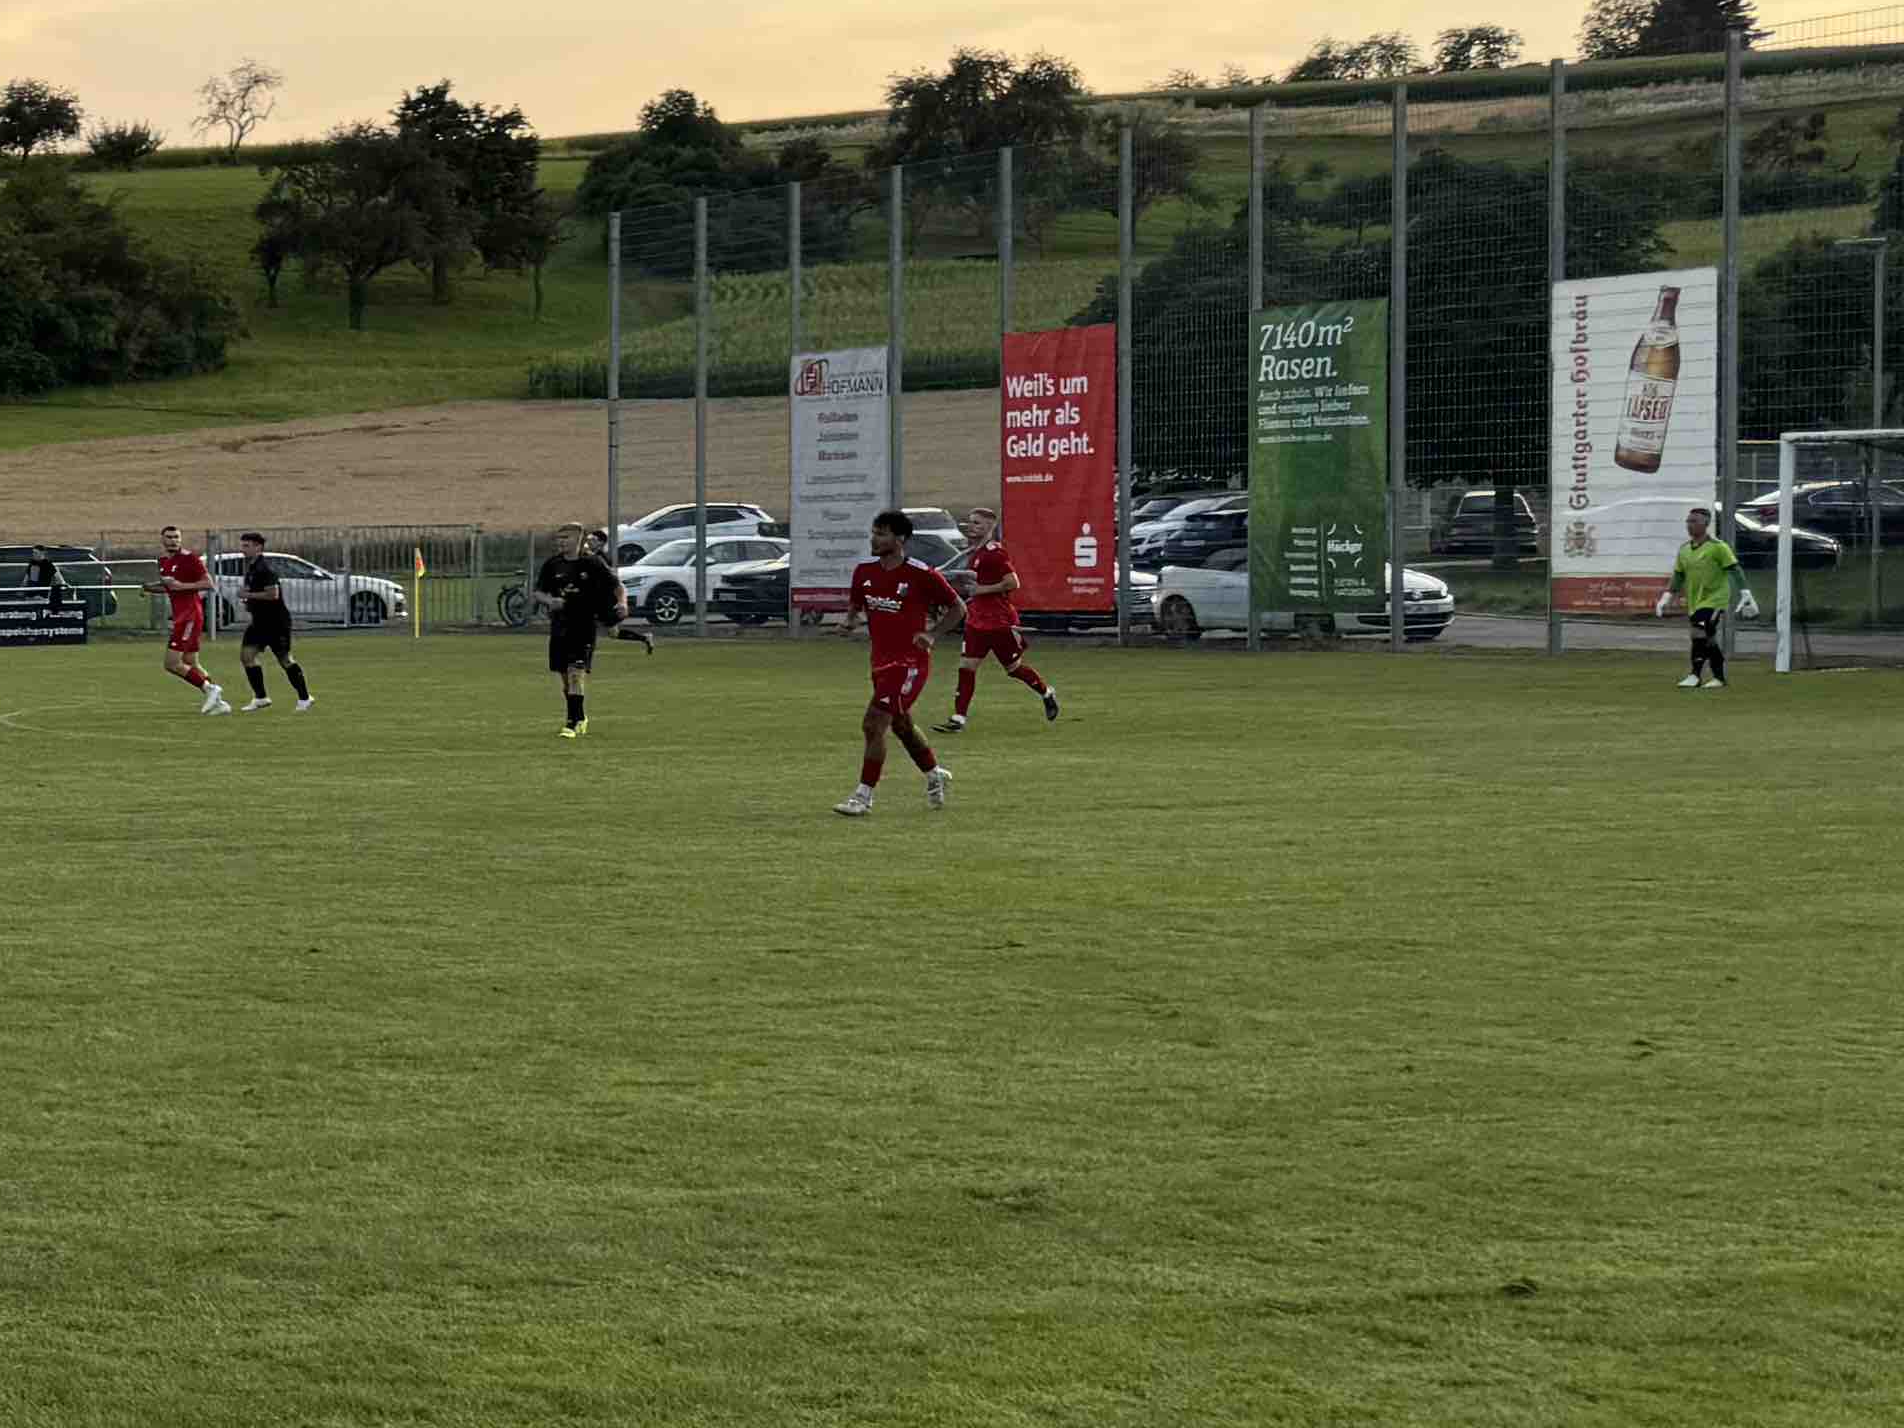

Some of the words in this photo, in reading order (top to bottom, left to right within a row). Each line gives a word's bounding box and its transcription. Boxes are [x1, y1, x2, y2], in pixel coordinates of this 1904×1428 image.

[1257, 354, 1338, 382] Rasen.
[824, 375, 884, 394] HOFMANN
[1006, 373, 1055, 398] Weil's
[1060, 376, 1088, 395] um
[1006, 403, 1051, 428] mehr
[1055, 401, 1081, 425] als
[1006, 433, 1044, 458] Geld
[1048, 431, 1095, 462] geht.
[1569, 389, 1592, 511] Stuttgarter
